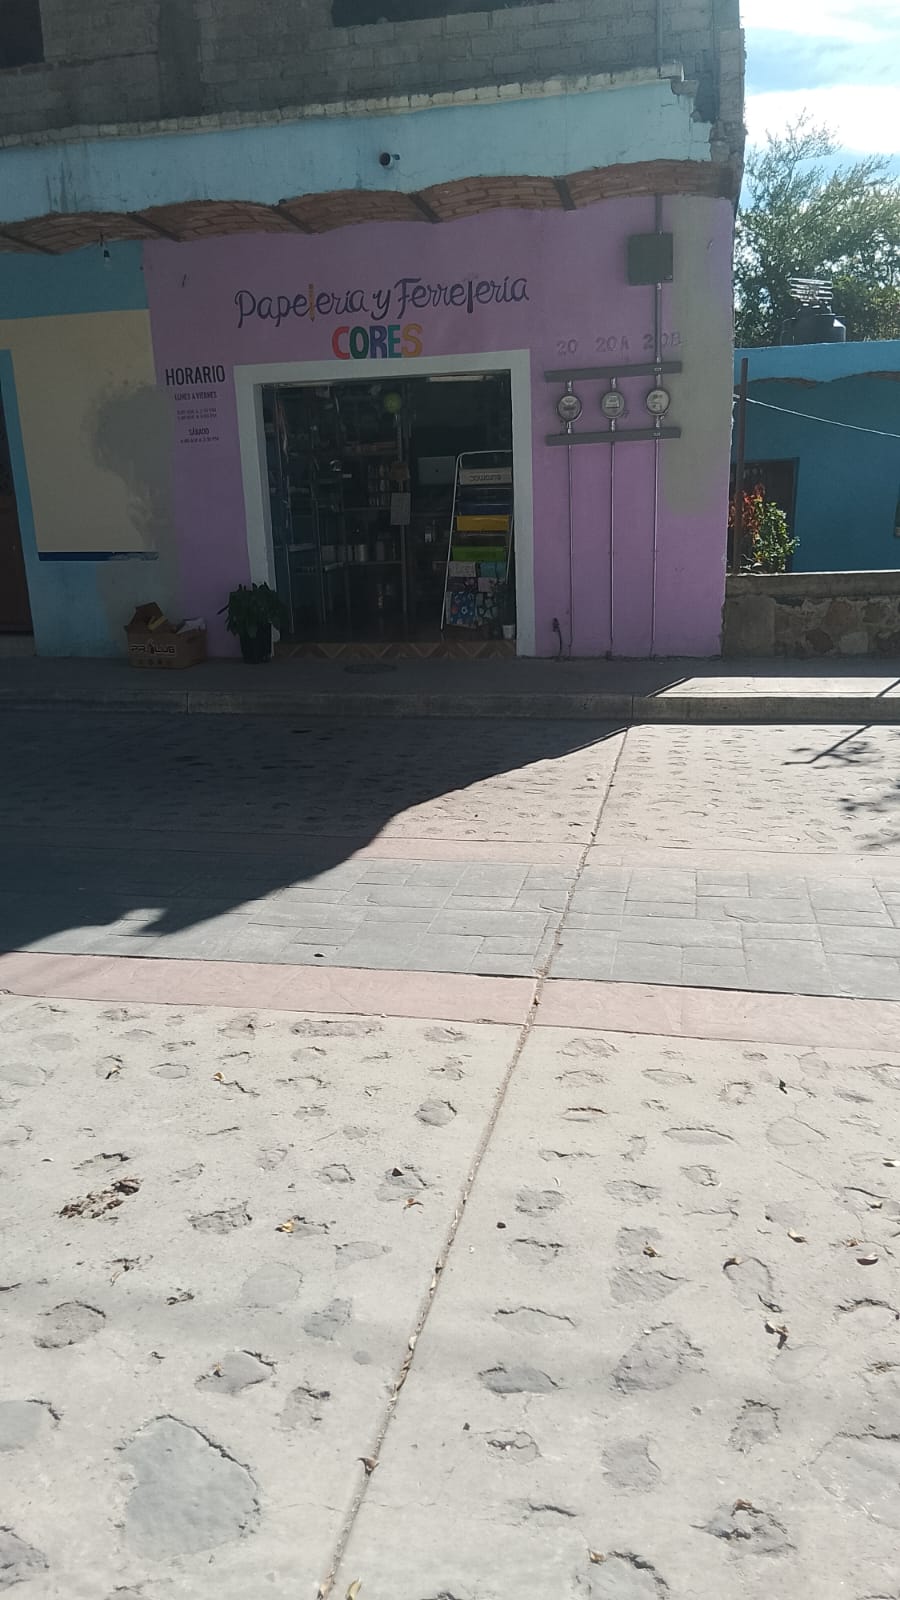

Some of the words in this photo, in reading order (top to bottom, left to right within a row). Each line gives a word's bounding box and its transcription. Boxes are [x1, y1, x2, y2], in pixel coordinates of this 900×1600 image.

[370, 288, 392, 321] y
[331, 322, 424, 360] CORES
[556, 338, 578, 356] 20
[164, 364, 226, 387] HORARIO
